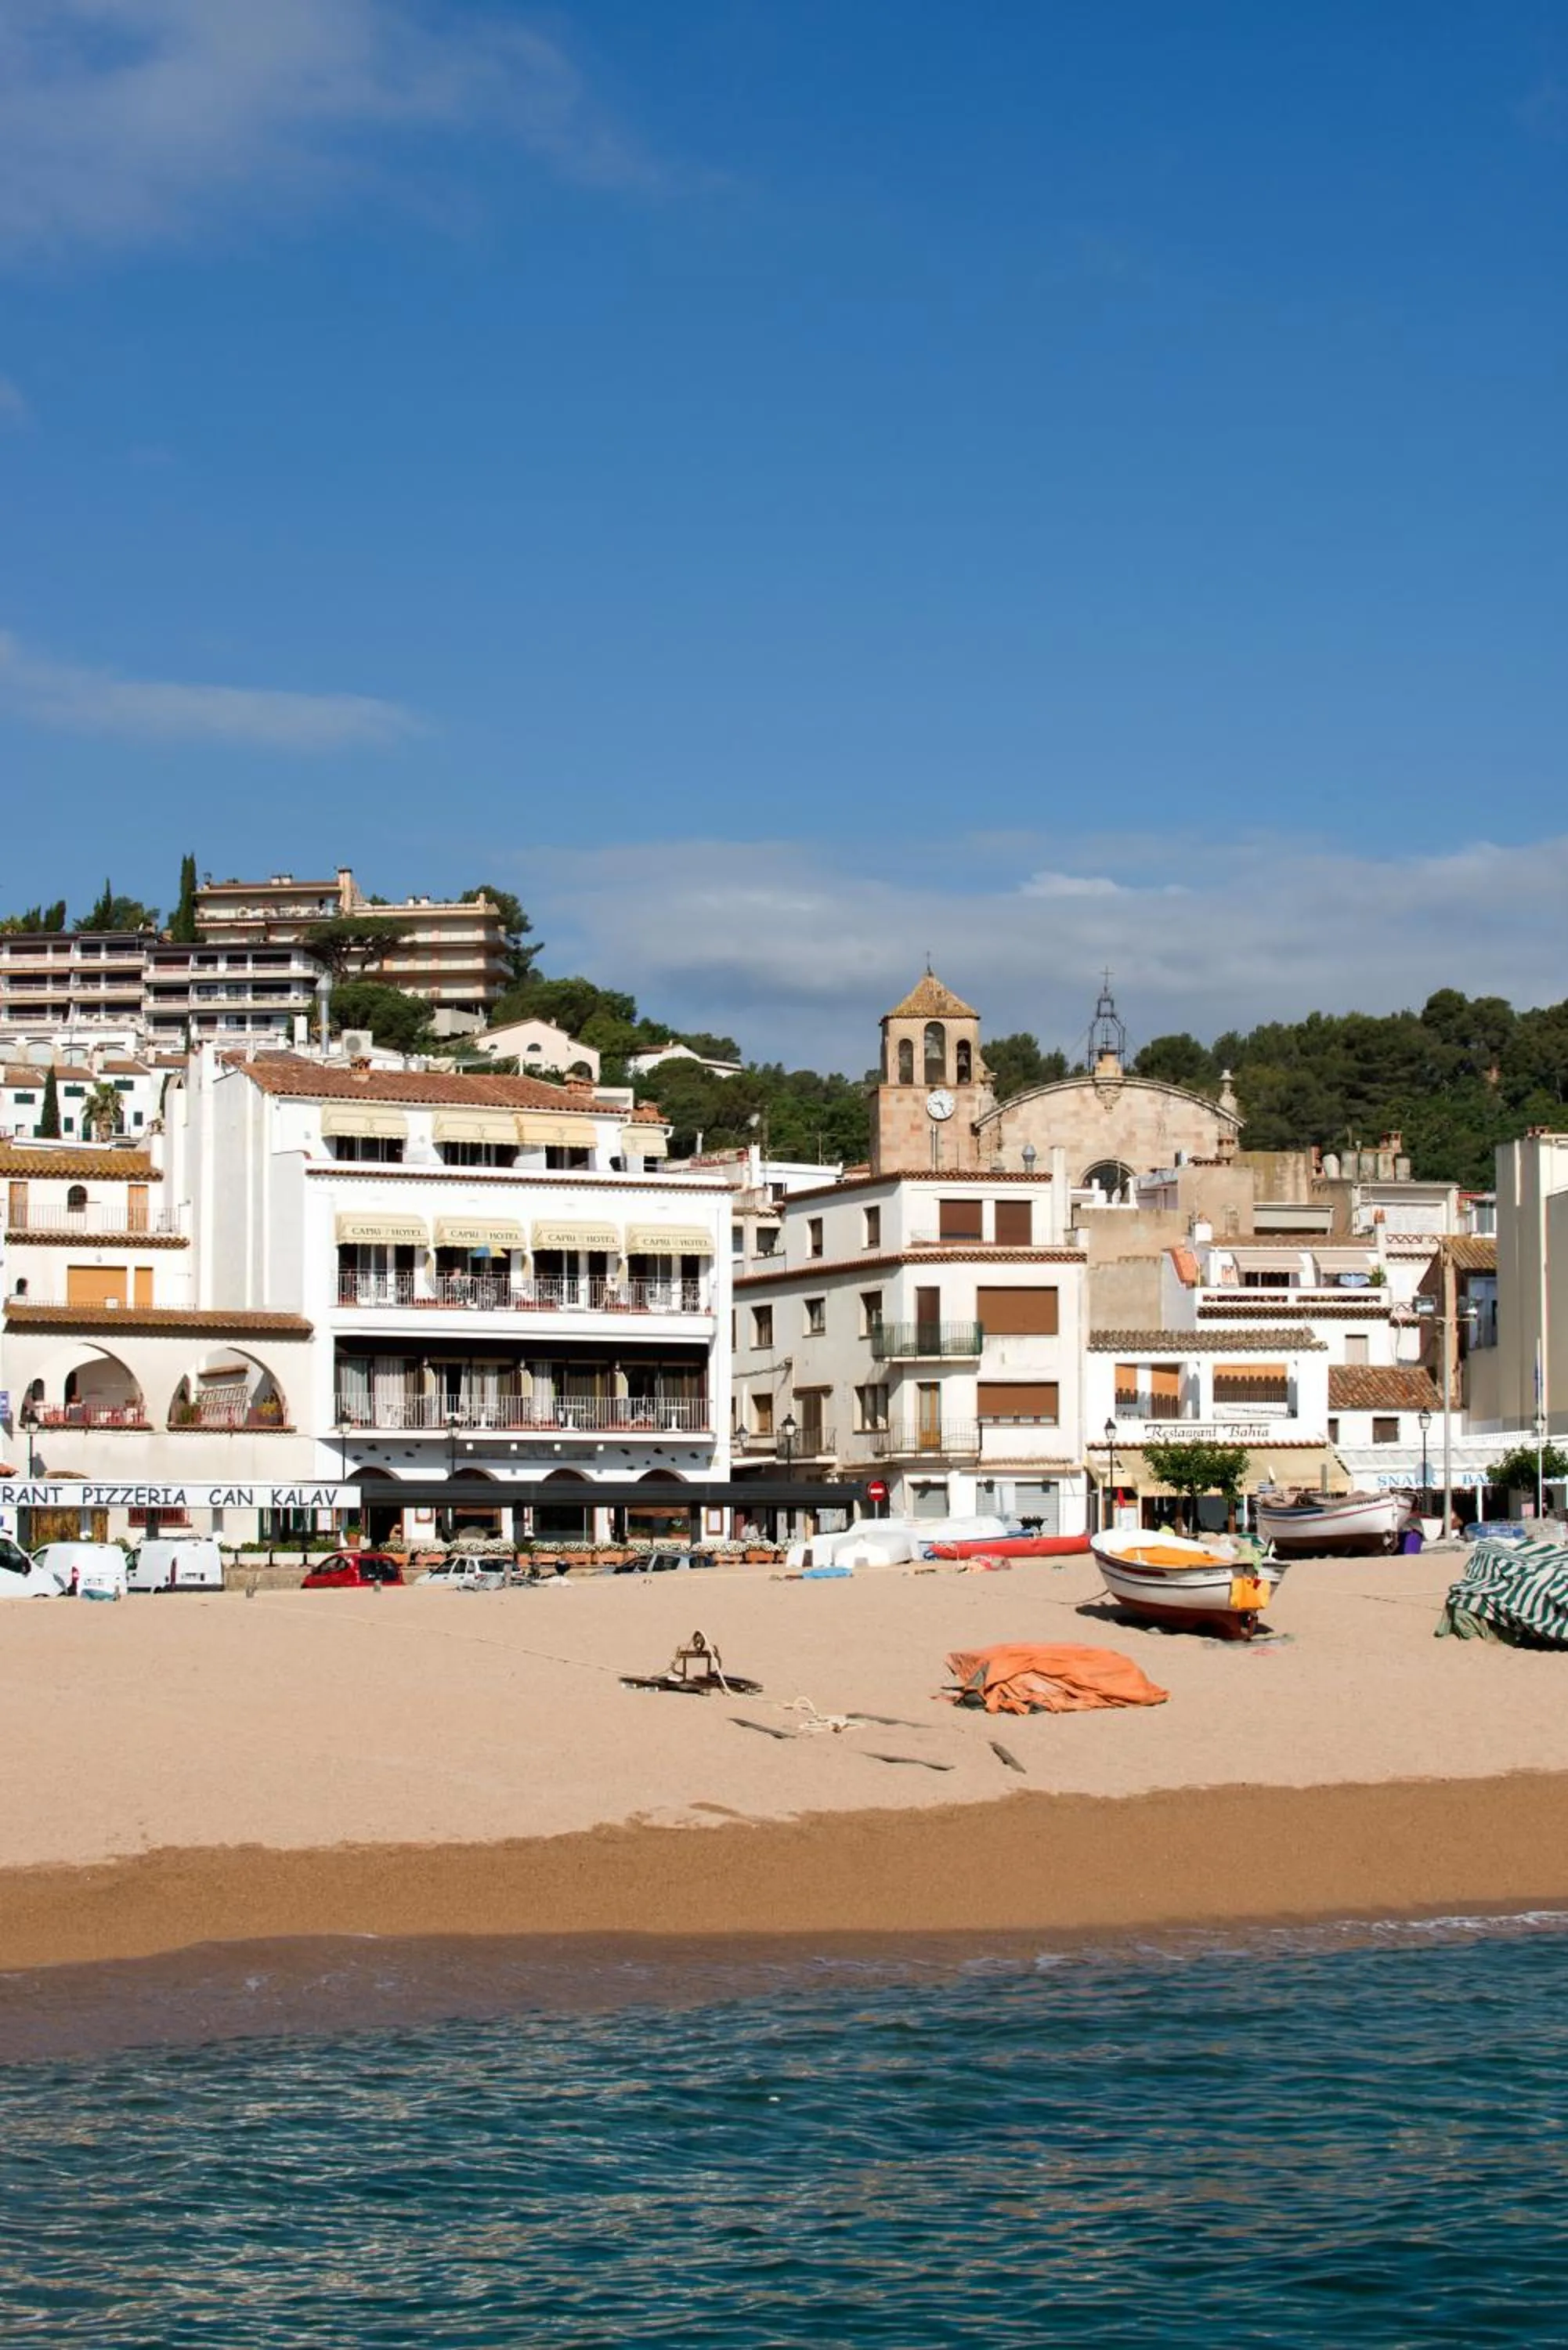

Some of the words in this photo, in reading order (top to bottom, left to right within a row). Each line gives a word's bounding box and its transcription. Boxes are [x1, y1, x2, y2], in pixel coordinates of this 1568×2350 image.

[450, 1230, 479, 1238] CAPRI
[587, 1235, 616, 1243] HOTEL
[643, 1238, 671, 1246] CAPRI
[2, 1485, 63, 1504] RANT
[81, 1486, 188, 1506] PIZZERIA
[208, 1488, 254, 1506] CAN
[271, 1488, 338, 1506] KALAV
